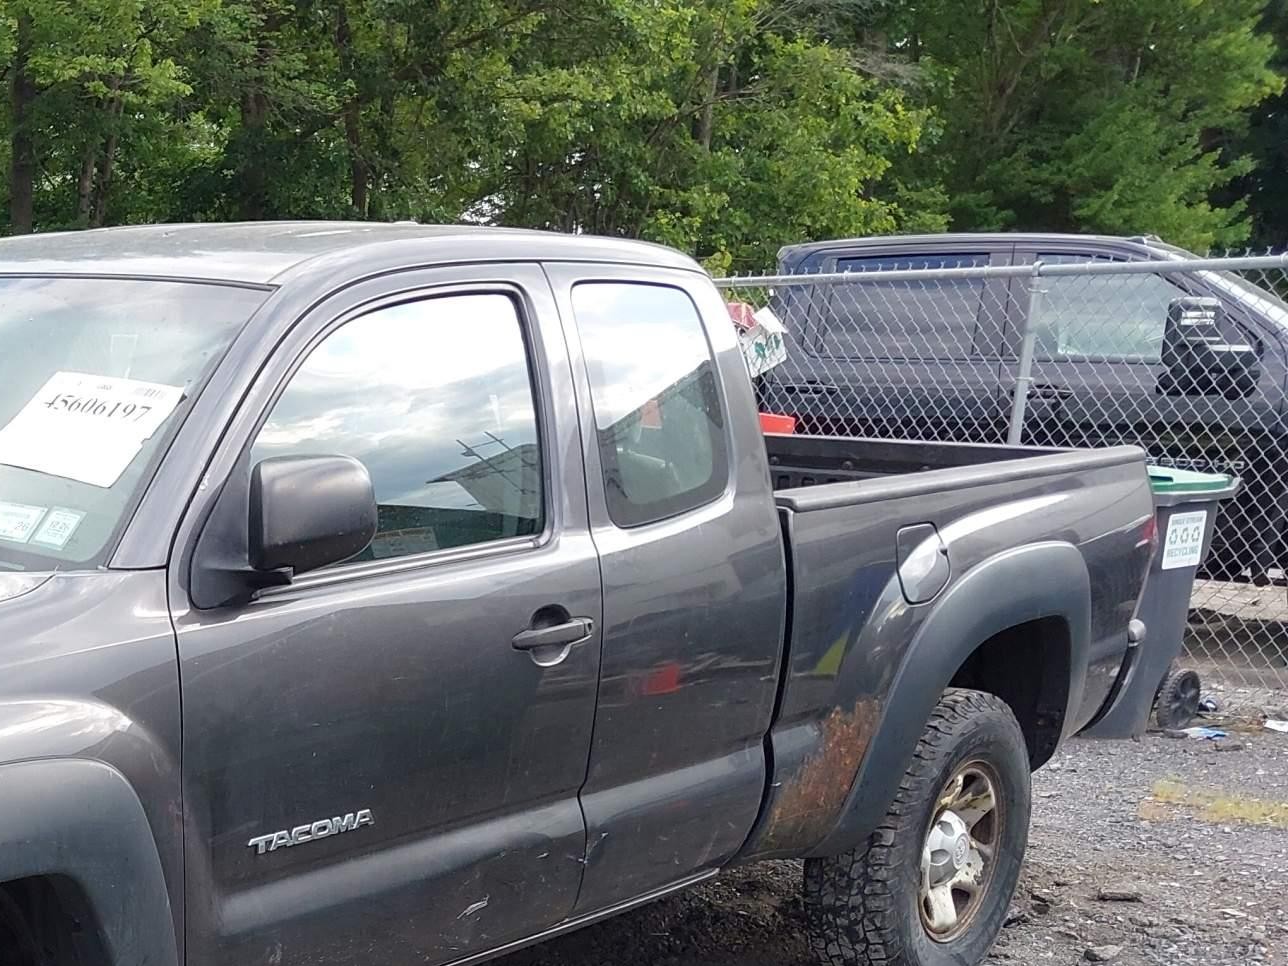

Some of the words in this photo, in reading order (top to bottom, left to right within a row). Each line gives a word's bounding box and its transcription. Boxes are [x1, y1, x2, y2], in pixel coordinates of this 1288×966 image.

[44, 393, 152, 422] 45606197
[1167, 545, 1199, 558] RECYCLING
[248, 808, 376, 855] TACOMA
